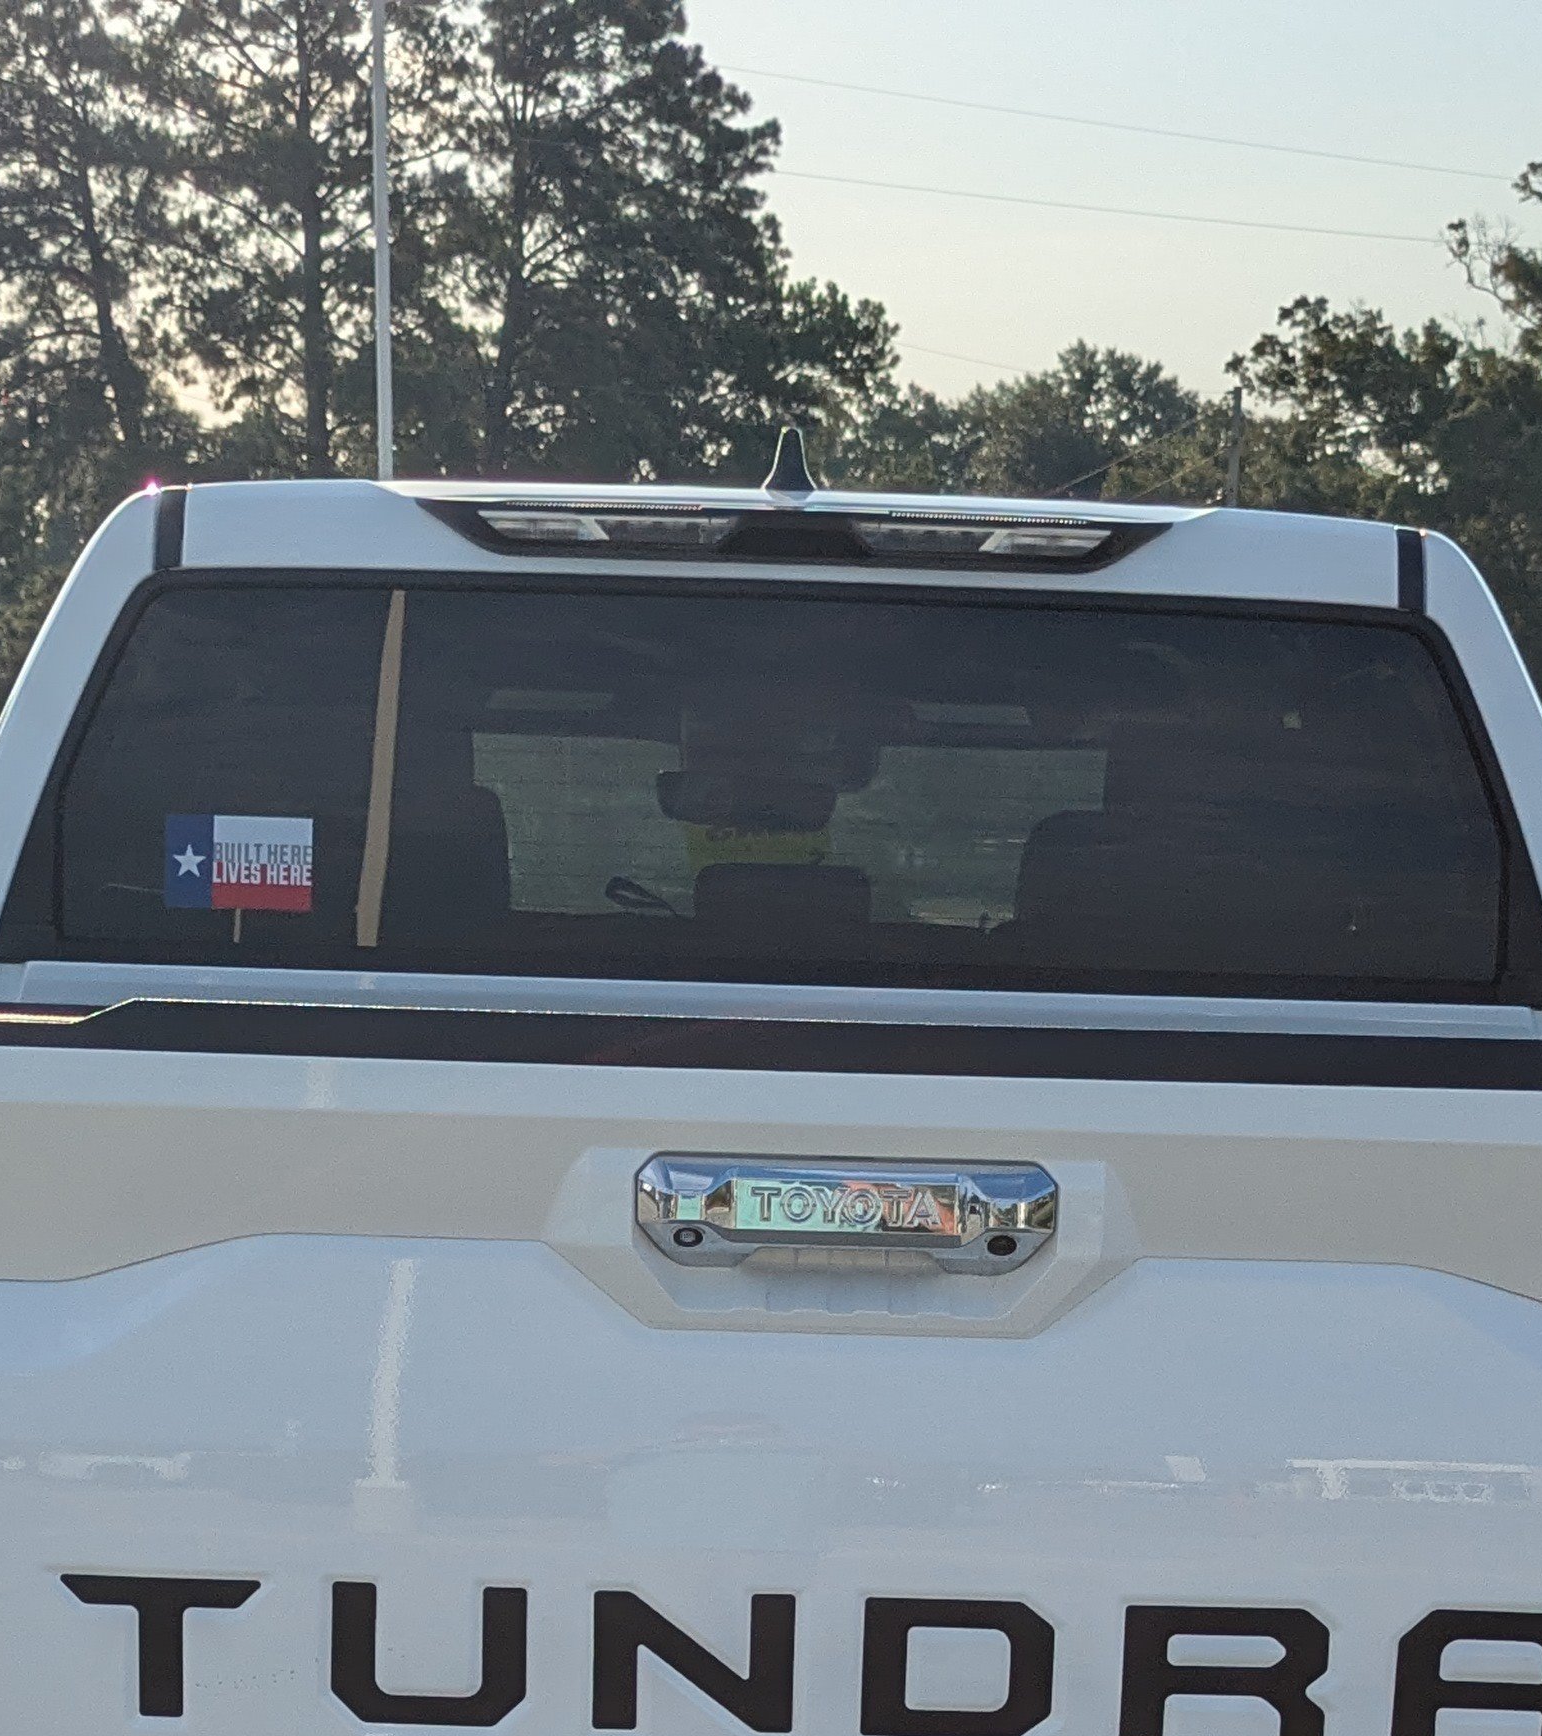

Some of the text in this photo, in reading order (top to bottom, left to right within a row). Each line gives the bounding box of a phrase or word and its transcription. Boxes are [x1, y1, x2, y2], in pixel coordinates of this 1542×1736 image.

[214, 842, 312, 865] BUILT HERE
[212, 862, 312, 886] LIVES HERE
[752, 1185, 941, 1228] TOYOTA
